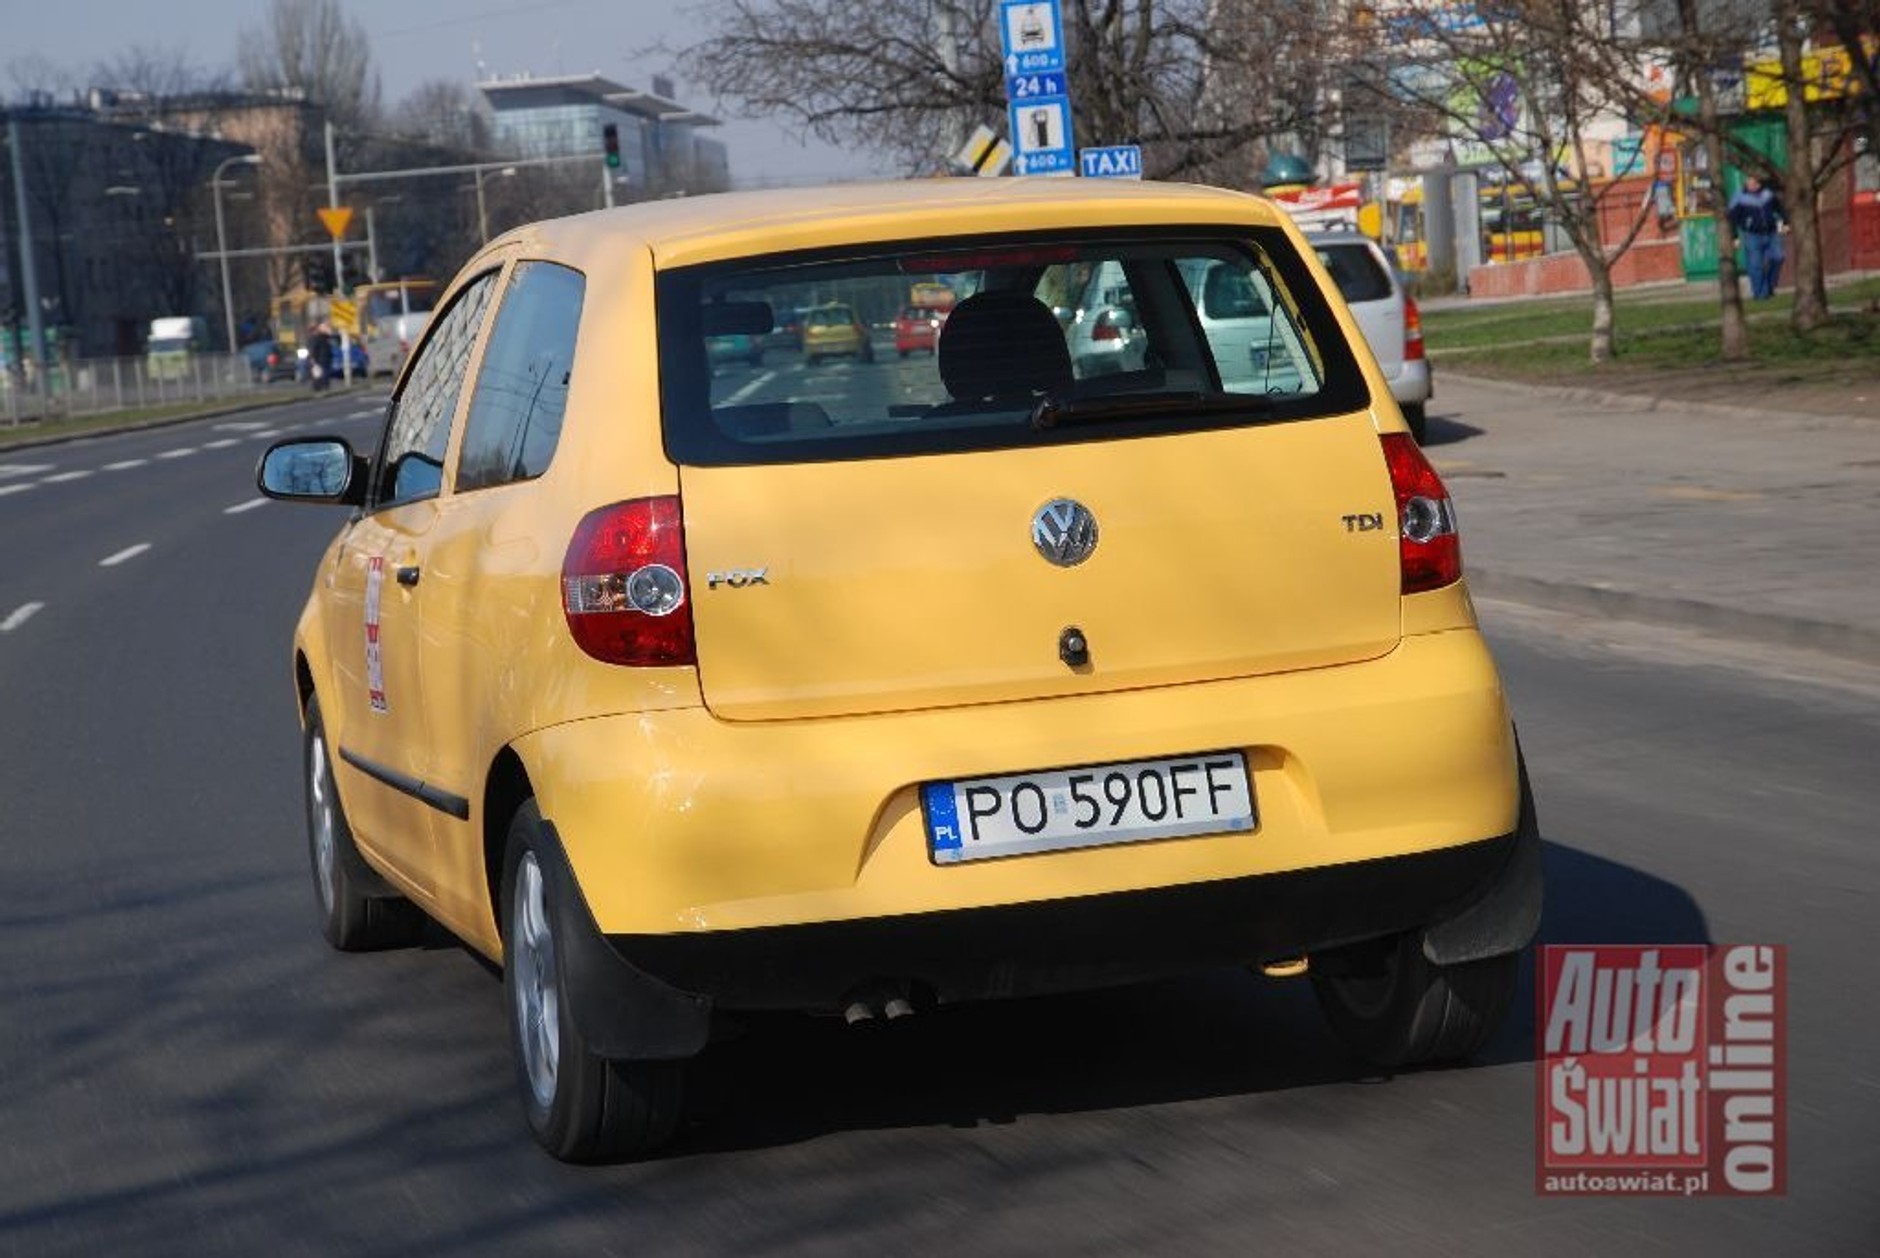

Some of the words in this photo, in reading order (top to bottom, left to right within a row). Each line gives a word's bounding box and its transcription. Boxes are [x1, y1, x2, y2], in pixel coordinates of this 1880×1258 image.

[1016, 77, 1040, 97] 24
[1046, 77, 1057, 94] h
[1085, 151, 1136, 175] TAXI
[1342, 513, 1383, 532] TDI
[706, 567, 769, 589] FOX
[966, 782, 1048, 841] PO
[1068, 760, 1234, 828] 590FF
[935, 826, 957, 841] PL
